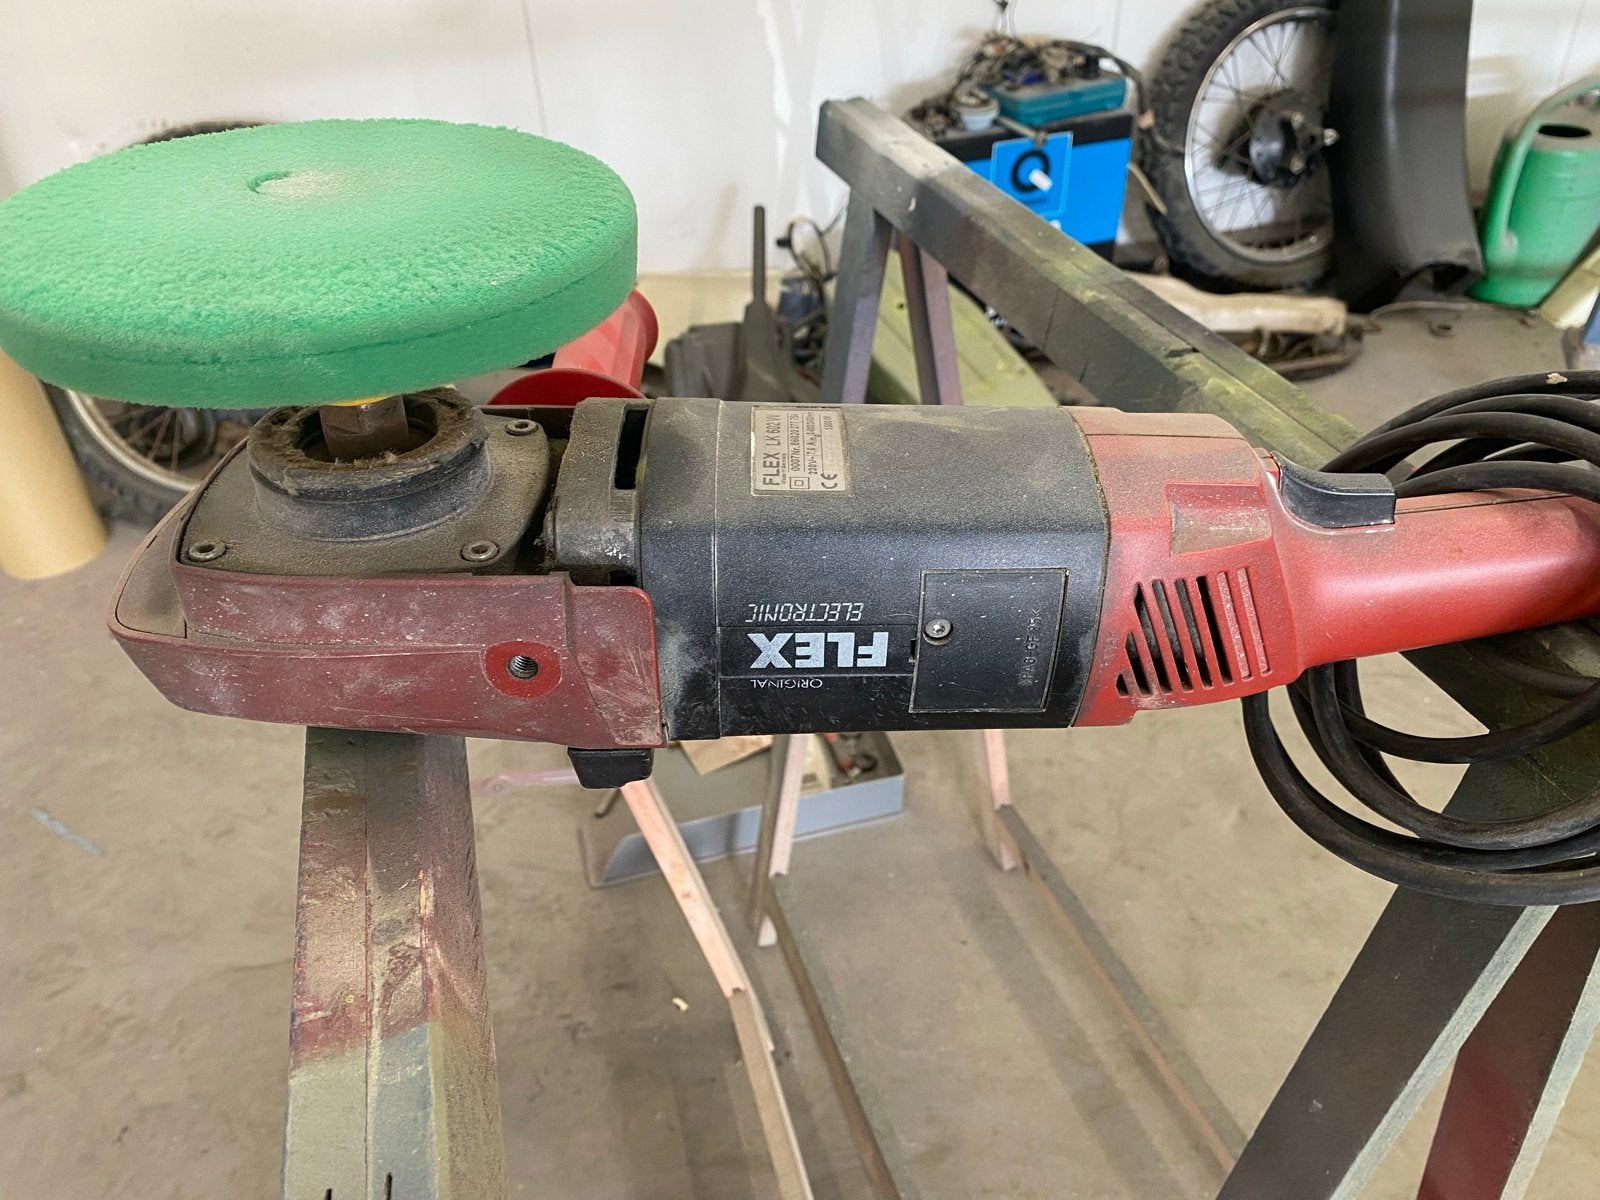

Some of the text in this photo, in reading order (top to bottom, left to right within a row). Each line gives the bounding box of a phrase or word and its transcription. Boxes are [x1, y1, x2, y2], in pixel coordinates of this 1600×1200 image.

[766, 435, 780, 446] LK
[763, 452, 780, 485] FLEX
[745, 602, 864, 622] ELECTRONIC
[747, 631, 889, 668] FLEX
[750, 678, 823, 688] ORIGINAL
